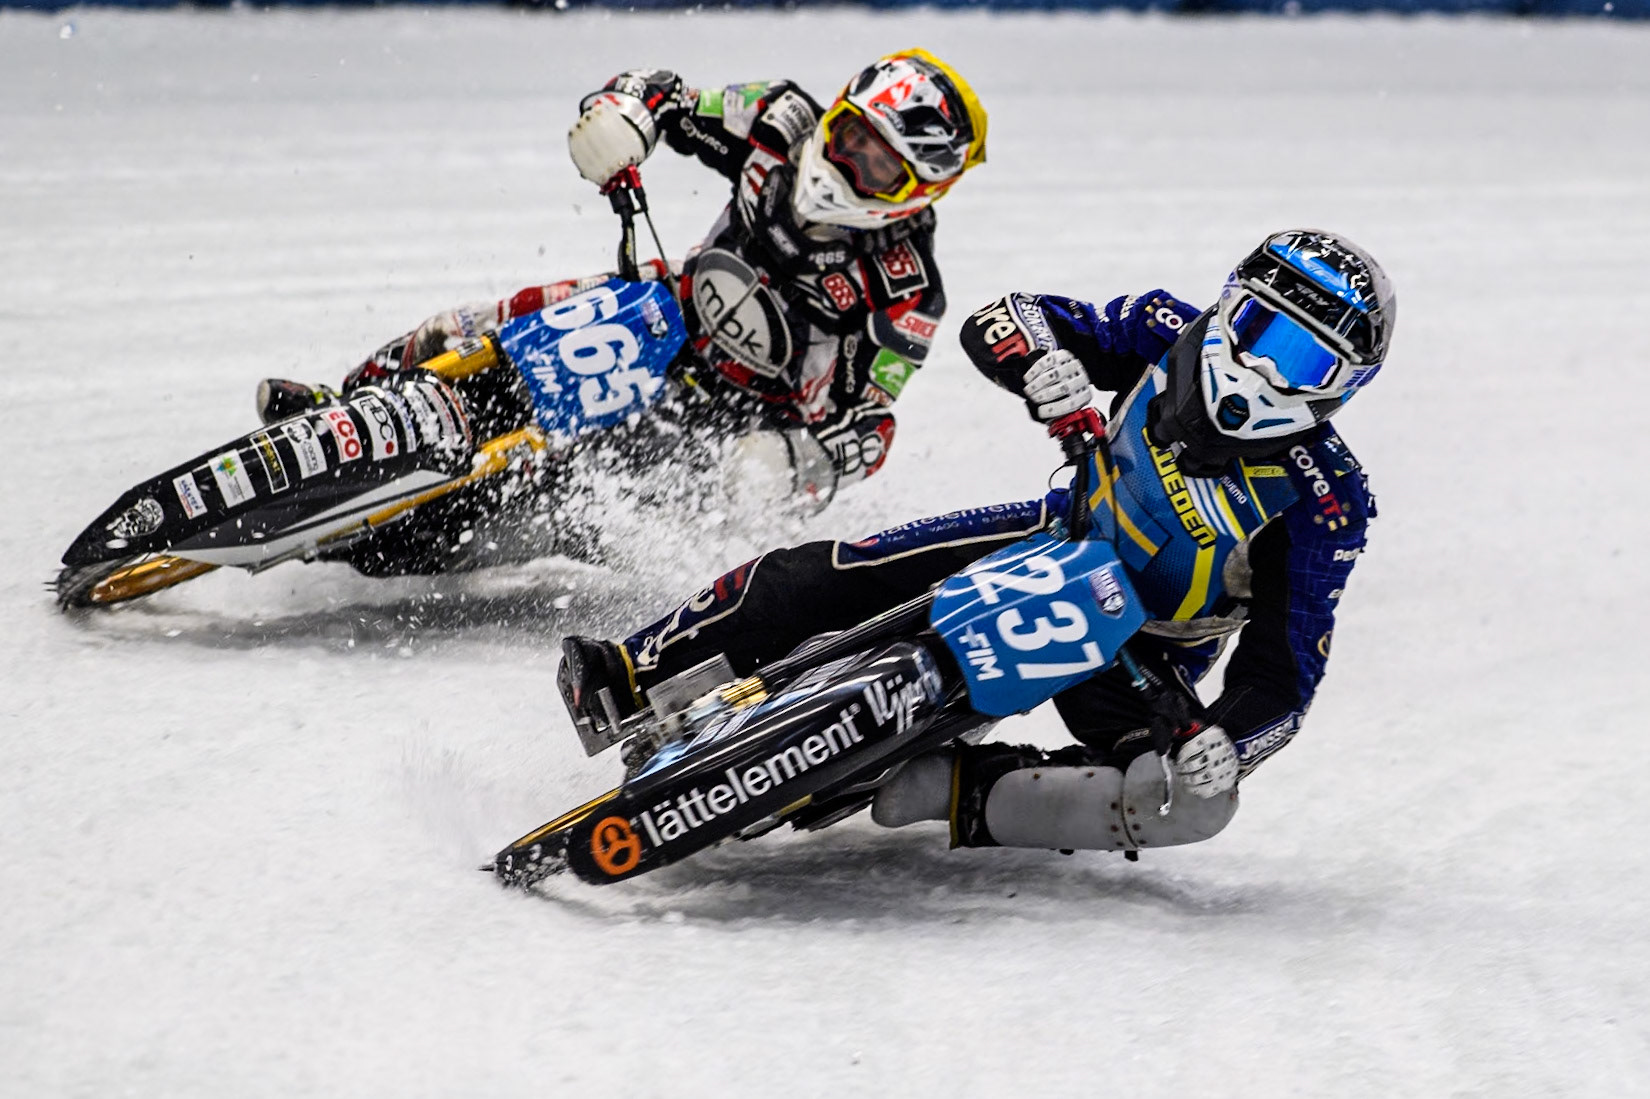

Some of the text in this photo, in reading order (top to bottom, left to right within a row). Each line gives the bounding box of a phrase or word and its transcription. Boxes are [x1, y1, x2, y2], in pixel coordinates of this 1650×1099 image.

[822, 271, 858, 311] 665
[541, 286, 654, 418] 665
[329, 411, 361, 458] ECO
[1289, 445, 1342, 517] coreIT
[1141, 427, 1218, 550] WEDEN
[958, 623, 1005, 682] FIM
[969, 555, 1106, 680] 237
[642, 707, 865, 848] lättelement
